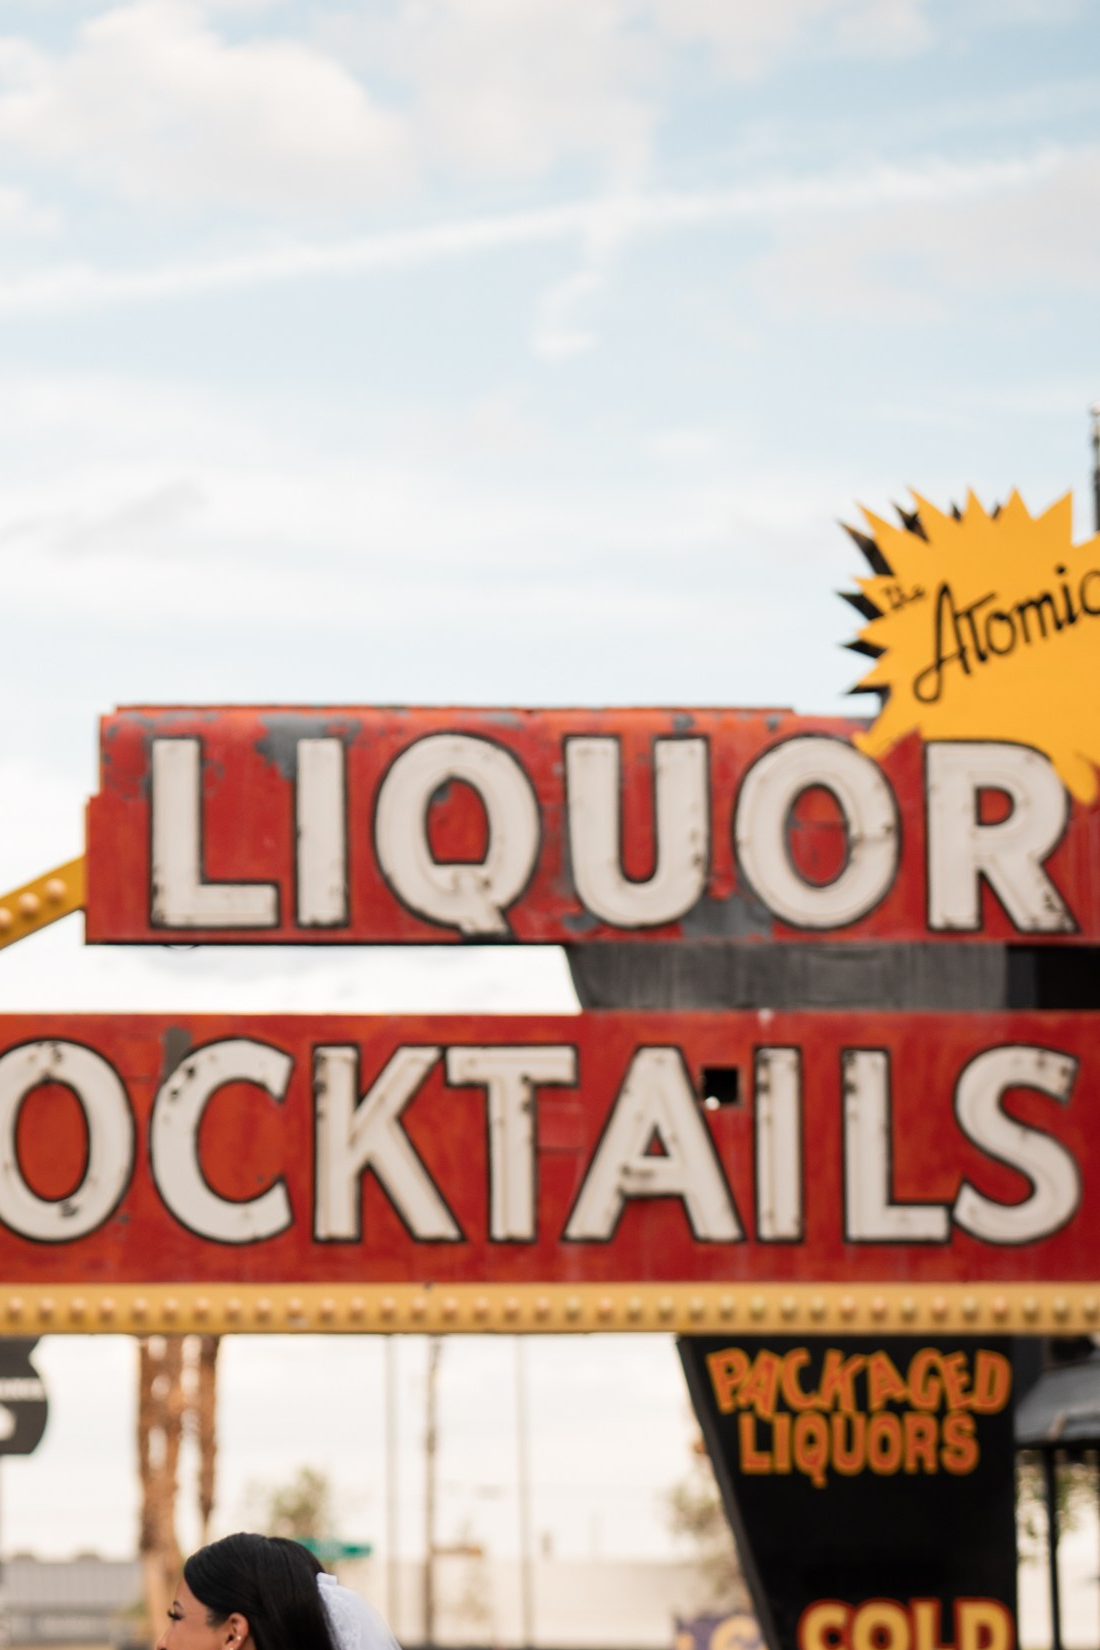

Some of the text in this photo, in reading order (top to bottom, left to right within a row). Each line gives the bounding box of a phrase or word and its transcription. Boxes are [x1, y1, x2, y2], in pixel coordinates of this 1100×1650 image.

[151, 732, 1078, 938] LIQUOR
[706, 1347, 1012, 1417] PACKAGED
[738, 1411, 979, 1488] LIQUORS
